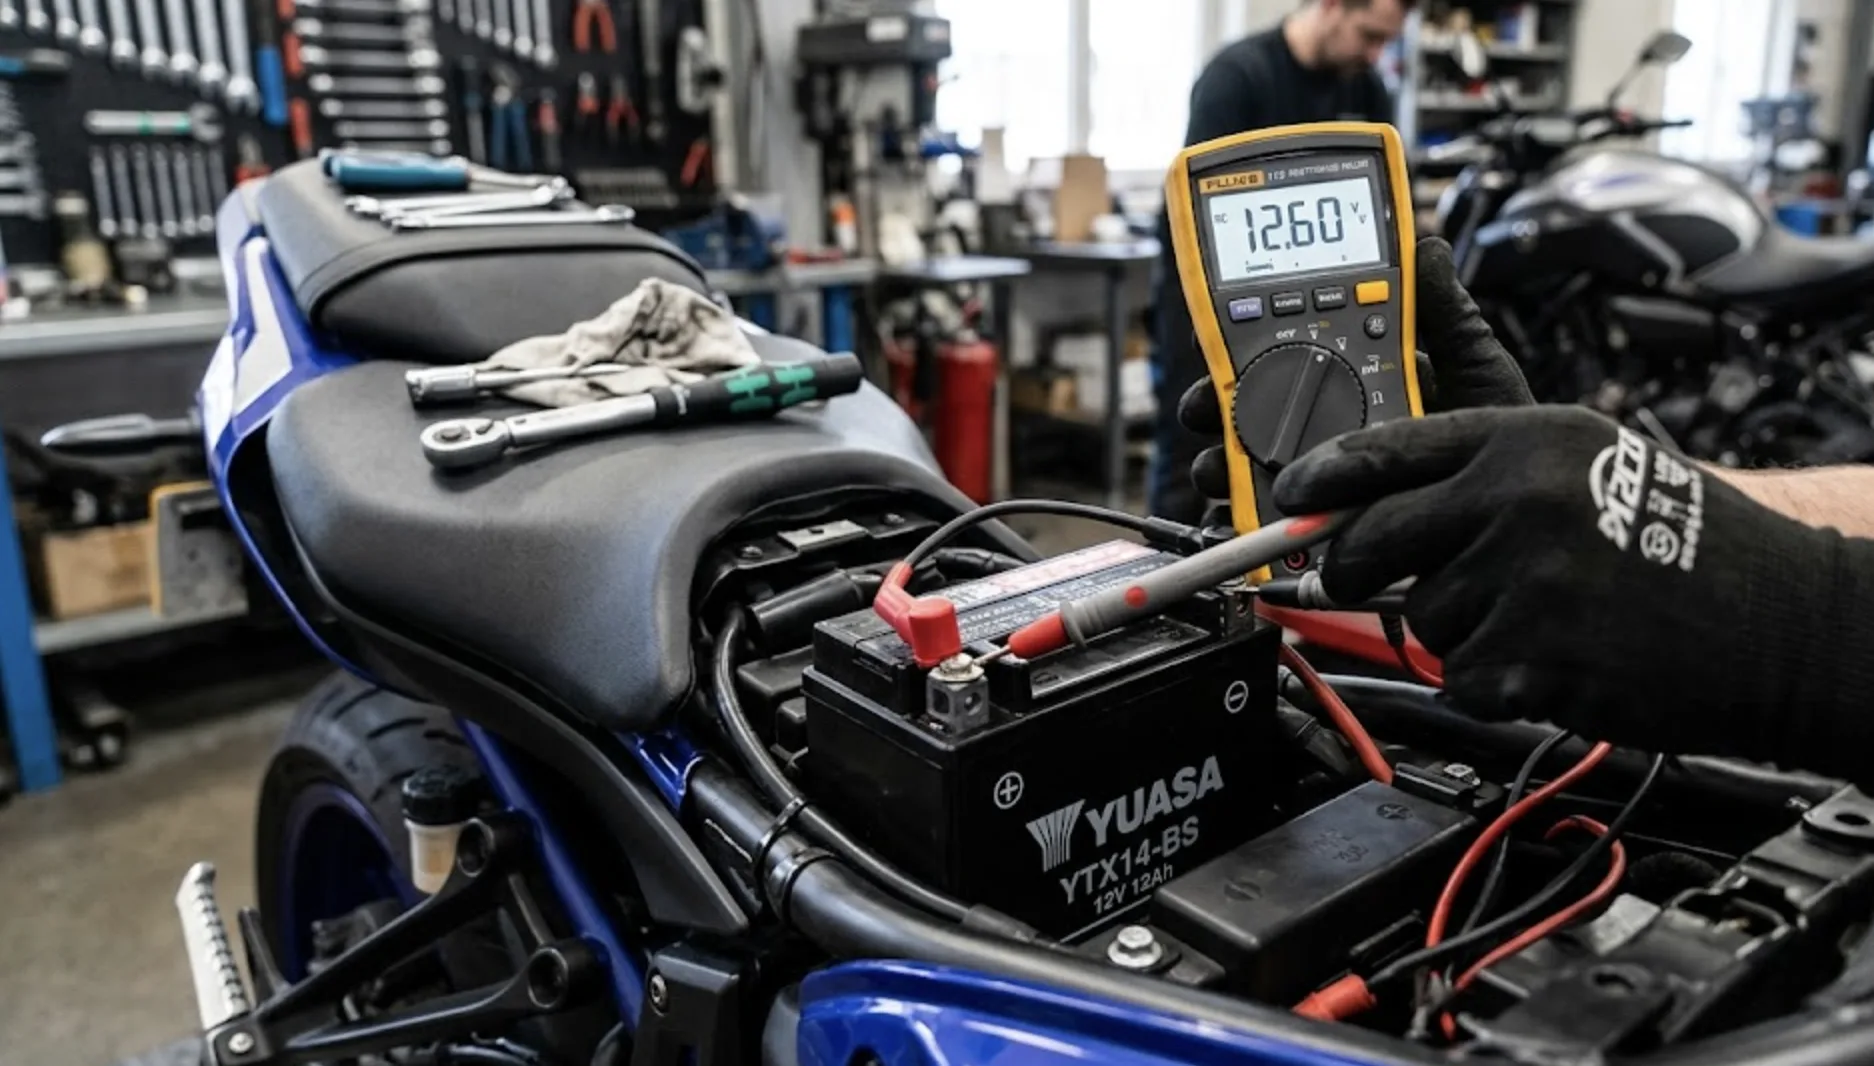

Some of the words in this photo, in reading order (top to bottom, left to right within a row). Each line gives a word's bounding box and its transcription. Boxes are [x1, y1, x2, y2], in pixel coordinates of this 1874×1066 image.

[1245, 197, 1344, 254] 12.60
[1085, 755, 1225, 847] YUASA
[1059, 815, 1199, 905] YTX14-BS
[1093, 883, 1127, 915] 12V
[1131, 863, 1174, 896] 12Ah
